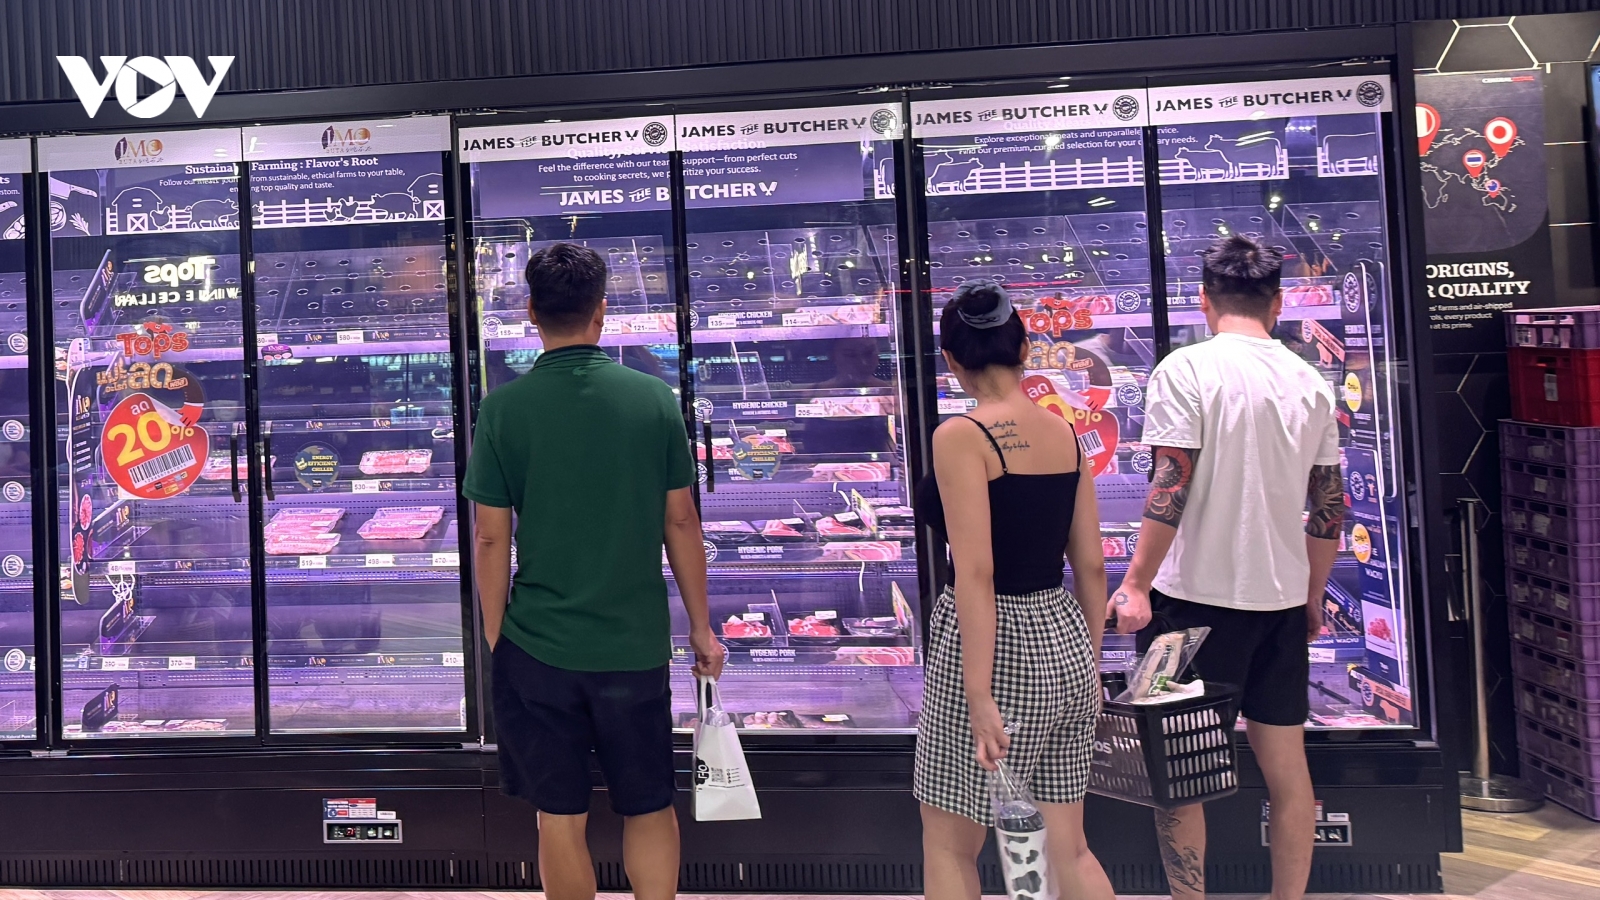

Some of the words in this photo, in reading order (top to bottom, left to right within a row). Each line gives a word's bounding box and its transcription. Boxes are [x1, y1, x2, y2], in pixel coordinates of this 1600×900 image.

[1156, 97, 1213, 112] JAMES
[1218, 96, 1238, 108] THE
[1243, 90, 1334, 107] BUTCHER
[915, 111, 973, 126] JAMES
[977, 108, 998, 122] THE
[1002, 104, 1090, 121] BUTCHER
[322, 126, 371, 149] IMO
[681, 124, 735, 138] JAMES
[739, 123, 760, 135] THE
[763, 118, 849, 135] BUTCHER
[974, 136, 1005, 146] Explore
[1079, 130, 1095, 140] and
[1096, 127, 1142, 139] unparallele
[116, 137, 163, 160] IMO
[463, 137, 515, 151] JAMES
[519, 135, 538, 147] THE
[541, 130, 623, 147] BUTCHER
[567, 147, 622, 160] Quality,
[682, 139, 766, 153] Satisfaction
[977, 147, 993, 155] our
[993, 144, 1033, 155] premium,
[1066, 140, 1104, 151] selection
[1105, 139, 1117, 149] for
[1117, 140, 1137, 150] your
[1171, 135, 1199, 145] needs.
[185, 163, 240, 176] Sustaina
[251, 161, 298, 173] Farming
[305, 158, 351, 170] Flavor's
[351, 156, 379, 167] Root
[538, 164, 556, 173] Feel
[556, 163, 572, 171] the
[572, 161, 615, 171] difference
[615, 159, 635, 169] with
[635, 160, 651, 169] our
[746, 153, 778, 163] perfect
[778, 151, 798, 160] cuts
[0, 176, 10, 185] ts
[159, 179, 184, 187] Follow
[268, 173, 310, 183] sustainable,
[311, 171, 335, 180] ethical
[335, 169, 357, 179] farms
[357, 170, 366, 178] to
[366, 170, 384, 180] your
[384, 168, 406, 178] table,
[573, 173, 584, 182] to
[584, 172, 617, 183] cooking
[617, 171, 650, 182] secrets,
[651, 171, 665, 179] we
[705, 167, 725, 178] your
[726, 165, 762, 175] success.
[260, 184, 273, 193] top
[274, 182, 299, 192] quality
[299, 182, 313, 190] and
[314, 180, 335, 189] taste.
[559, 189, 624, 207] JAMES
[628, 187, 652, 204] THE
[656, 182, 758, 202] BTCHER
[1437, 280, 1531, 300] QUALITY
[1438, 304, 1459, 312] farms
[1459, 303, 1473, 311] and
[1473, 302, 1514, 311] air-shipped
[1444, 313, 1464, 322] every
[1464, 312, 1494, 321] product
[1451, 322, 1474, 331] prime.
[116, 331, 189, 359] Tops
[1026, 383, 1050, 400] ลด
[130, 400, 150, 416] ลด
[107, 411, 194, 467] 20%
